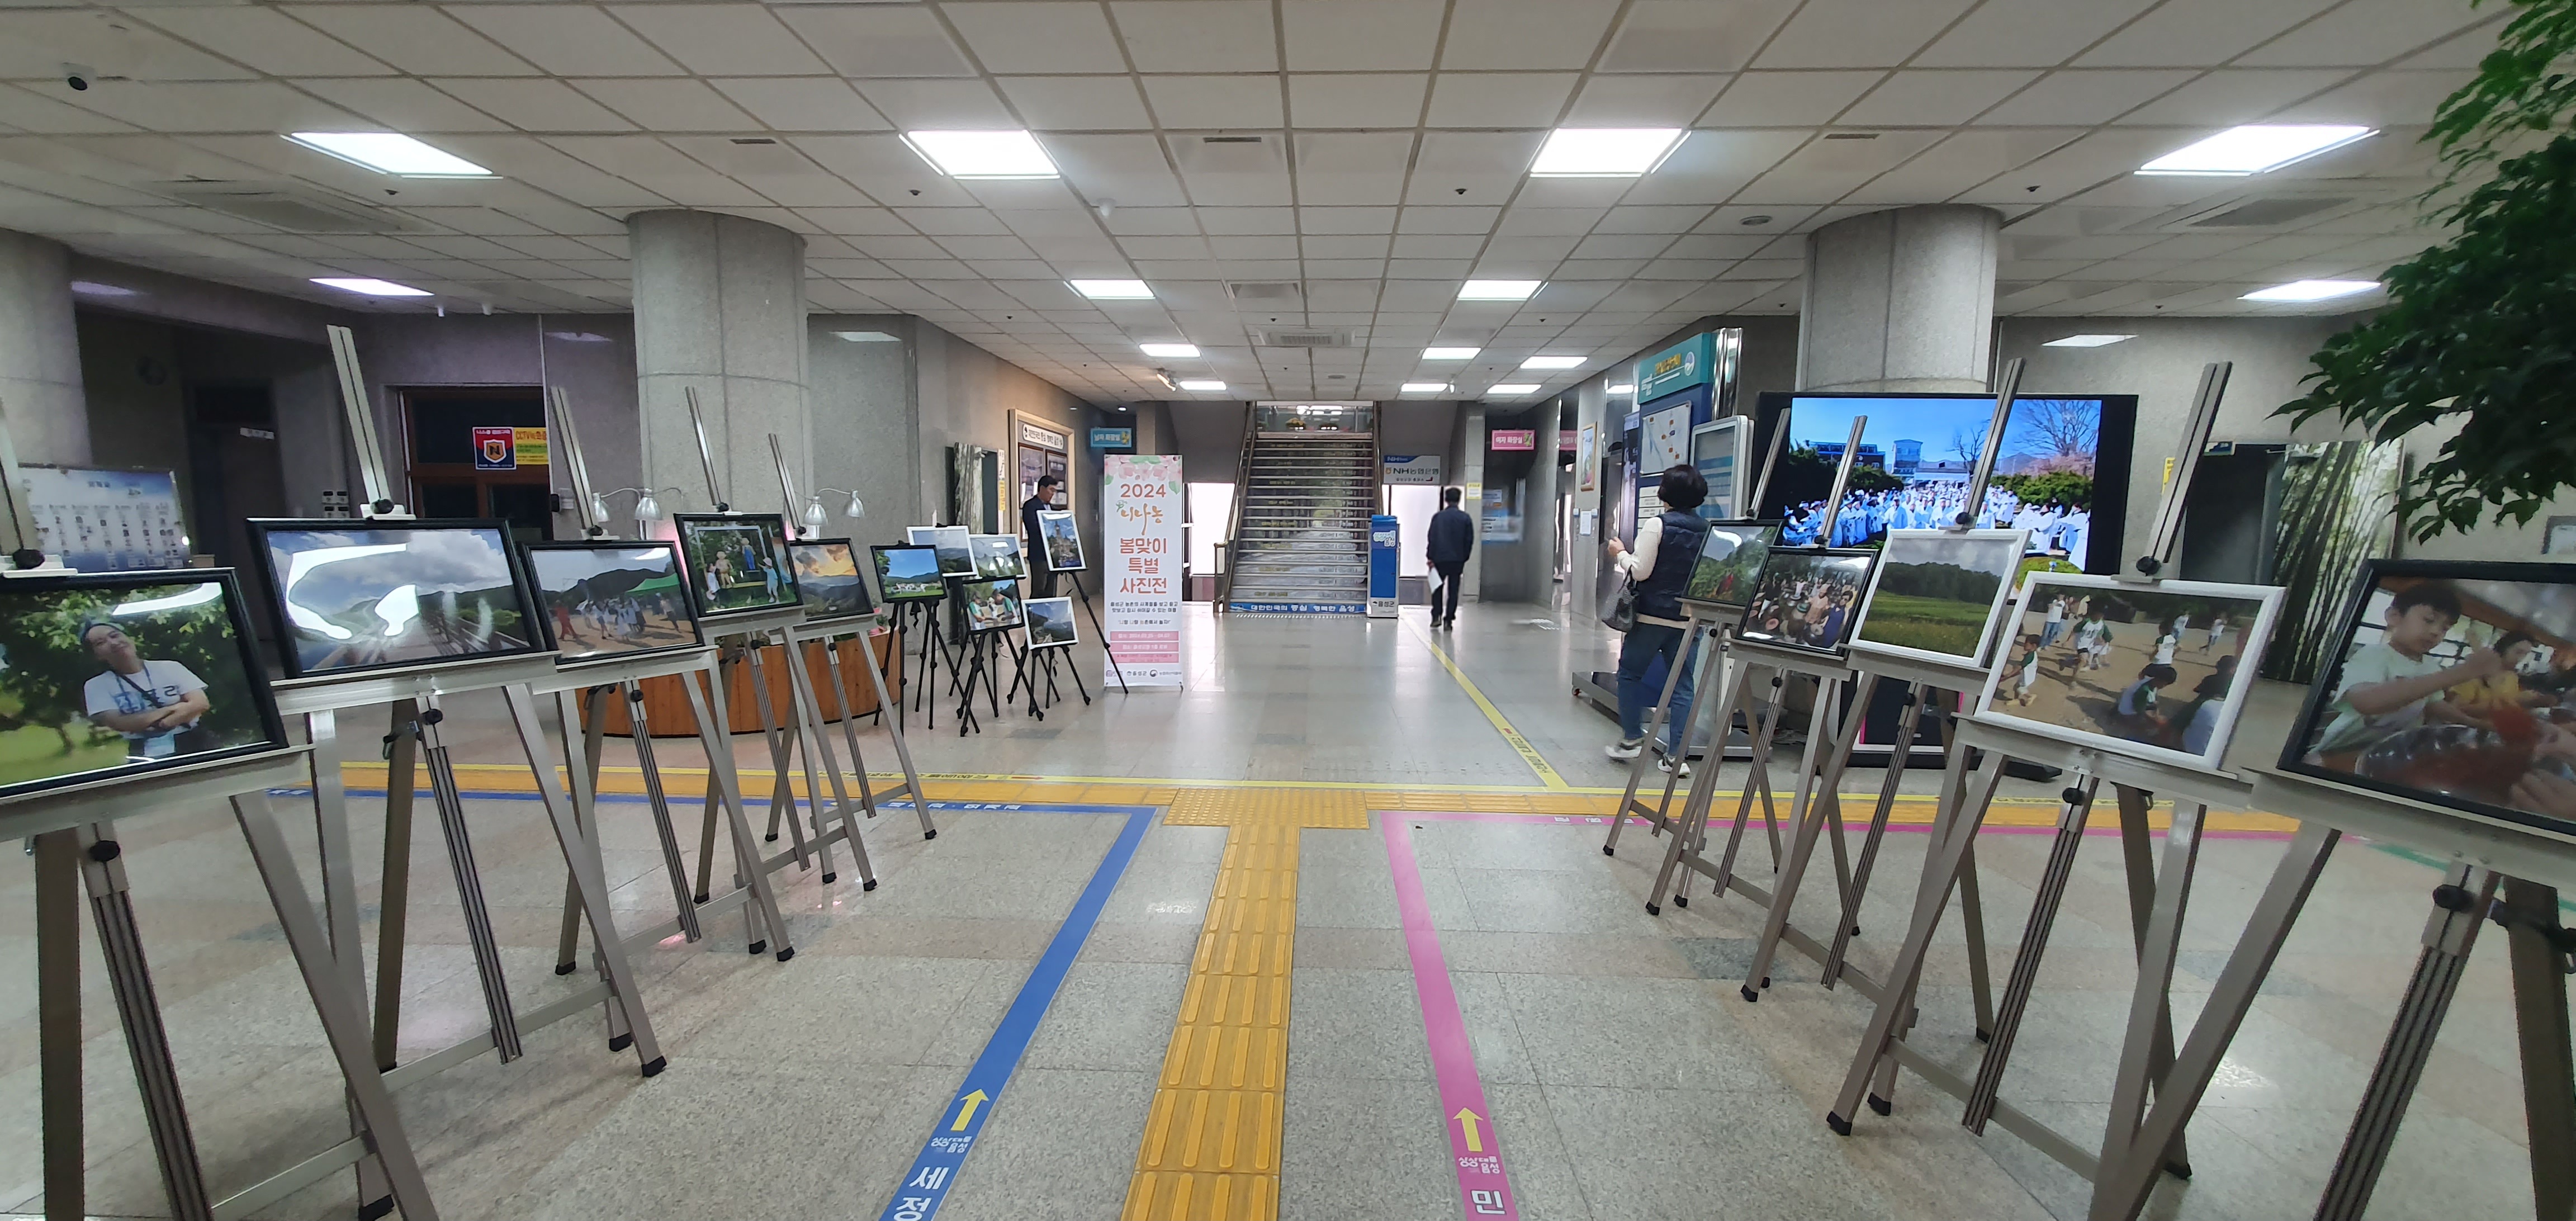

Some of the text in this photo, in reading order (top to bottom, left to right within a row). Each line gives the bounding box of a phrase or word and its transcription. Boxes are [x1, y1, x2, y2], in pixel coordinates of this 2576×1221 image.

[1120, 484, 1167, 498] 2024
[1119, 537, 1167, 554] 봄맞이
[1128, 557, 1159, 574] 특별
[1119, 577, 1167, 594] 사진전
[1471, 1190, 1505, 1214] 민
